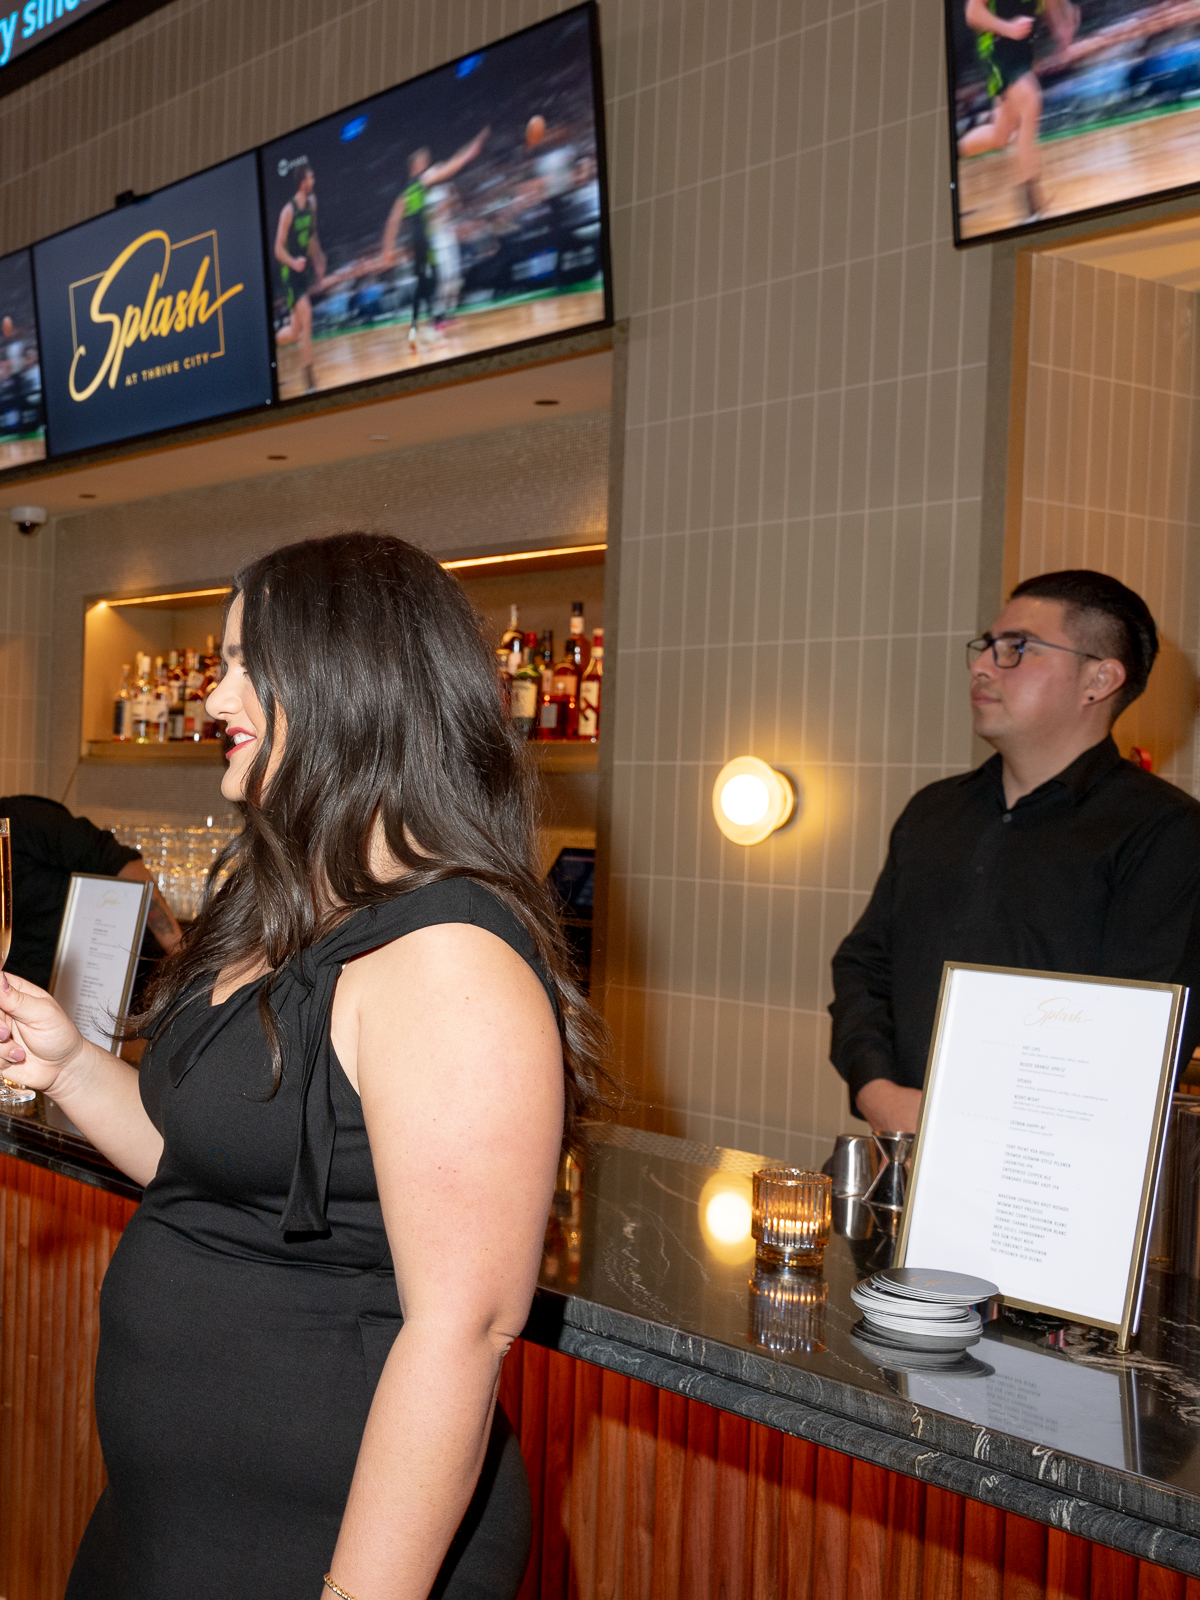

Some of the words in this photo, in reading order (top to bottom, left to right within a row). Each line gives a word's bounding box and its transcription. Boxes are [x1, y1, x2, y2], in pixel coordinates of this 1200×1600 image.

[68, 229, 245, 401] Splash
[125, 372, 138, 387] AT
[141, 360, 180, 382] THRIVE
[182, 351, 209, 370] CITY
[1023, 996, 1094, 1026] Splash
[1002, 1167, 1026, 1176] ENTERPRISE
[1001, 1174, 1021, 1182] STANDARD
[1017, 1197, 1039, 1206] SPARKLING
[1024, 1207, 1043, 1215] PRESTIGE
[1030, 1216, 1052, 1224] SAUVIGNON
[1029, 1224, 1052, 1233] SAUVIGNON
[1018, 1230, 1045, 1239] CHARDONNAY
[999, 1249, 1018, 1257] PRISONER
[1002, 1241, 1023, 1250] CABERNET
[1024, 1247, 1047, 1256] SAUVIGNON
